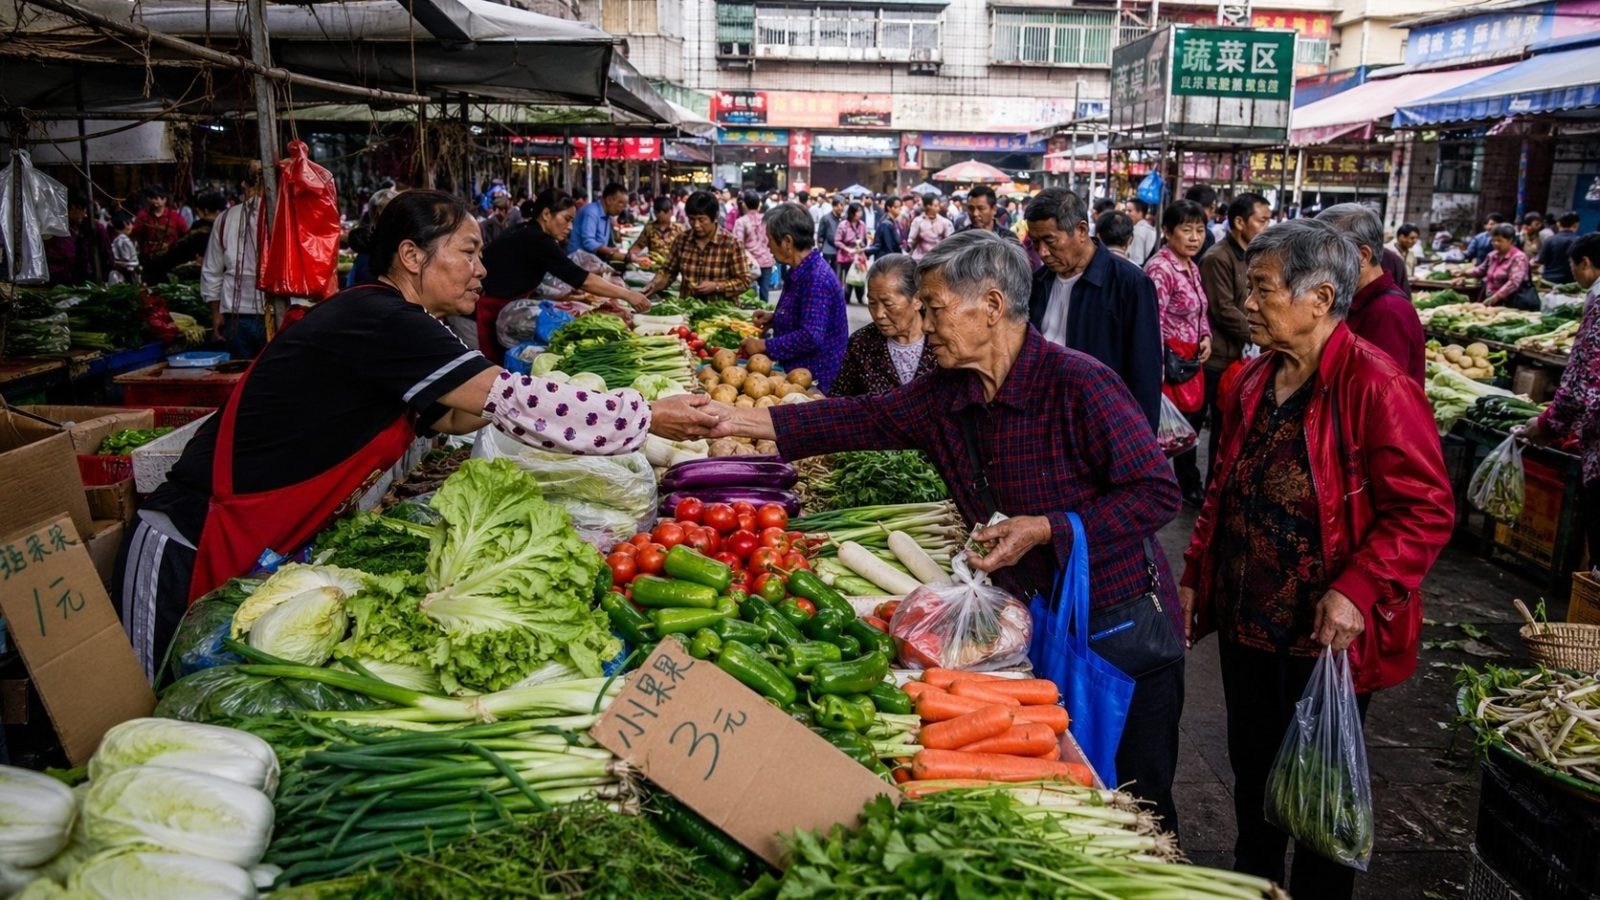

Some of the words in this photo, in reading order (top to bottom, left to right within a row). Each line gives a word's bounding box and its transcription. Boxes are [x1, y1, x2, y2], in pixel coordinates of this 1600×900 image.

[1181, 38, 1279, 74] 蔬菜区
[33, 576, 85, 637] 1元
[615, 654, 695, 749] 小果果
[669, 708, 748, 781] 3元
